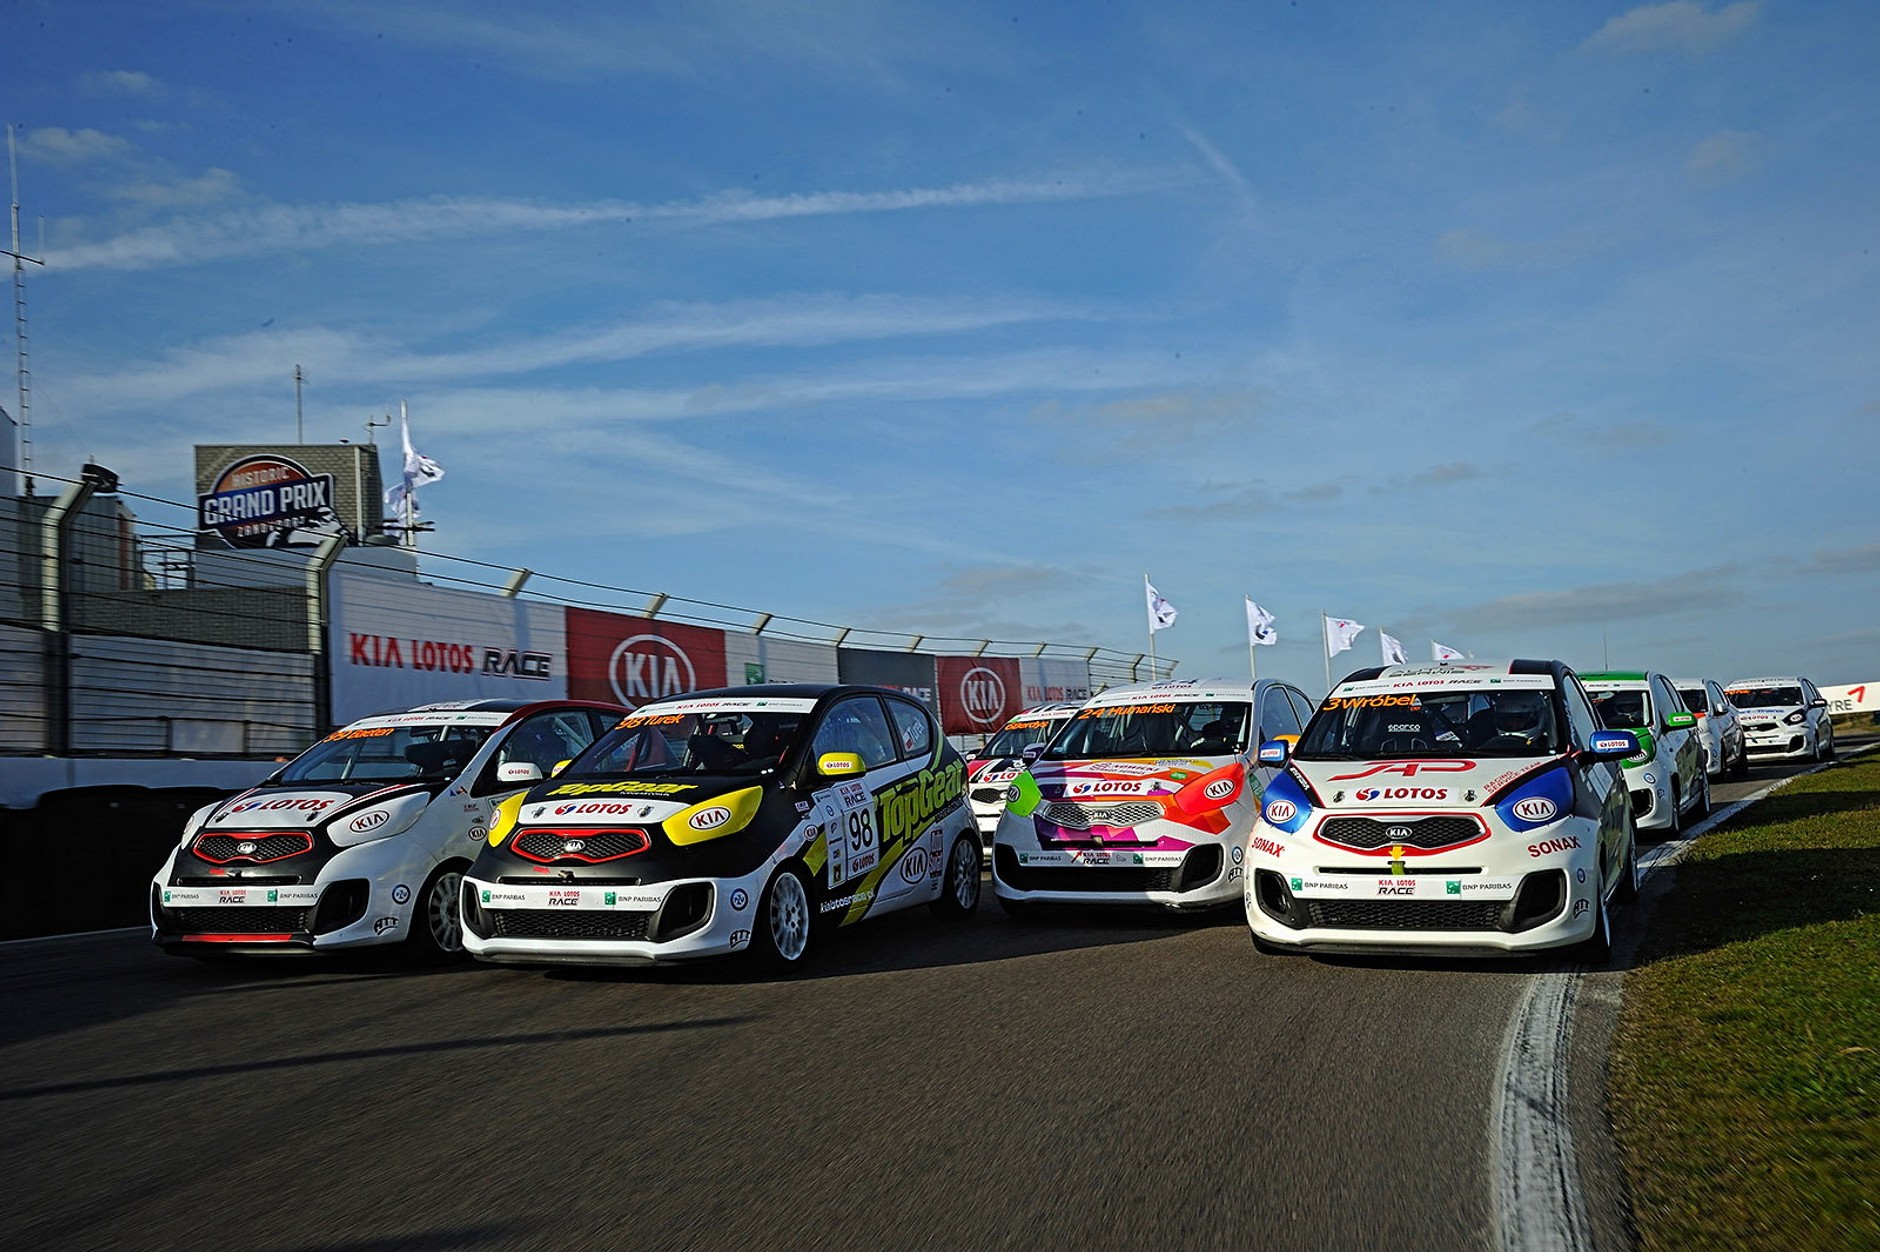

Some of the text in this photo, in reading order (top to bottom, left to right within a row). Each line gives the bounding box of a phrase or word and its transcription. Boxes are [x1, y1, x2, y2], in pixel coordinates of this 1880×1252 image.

[231, 466, 290, 487] HISTORIC
[204, 481, 326, 525] GRAND PRIX
[350, 632, 553, 681] KIA LOTOS RACE
[624, 652, 682, 699] KIA
[967, 680, 999, 710] KIA
[1066, 688, 1087, 701] RACE
[1322, 693, 1418, 711] 3 Wróbel
[1077, 704, 1176, 720] 24 Humański
[614, 713, 686, 731] 98 Turek
[1387, 724, 1421, 733] sparco
[840, 786, 850, 795] KIA
[1094, 782, 1142, 792] LOTOS
[1211, 782, 1232, 796] KIA
[1384, 788, 1448, 800] LOTOS
[258, 799, 335, 811] LOTOS
[844, 792, 867, 807] RACE
[879, 758, 964, 843] TopGear
[576, 804, 632, 814] LOTOS
[1271, 807, 1289, 817] KIA
[1522, 802, 1551, 816] KIA
[355, 816, 385, 830] KIA
[696, 810, 726, 827] KIA
[471, 828, 484, 839] KIA
[849, 808, 873, 851] 98
[1390, 828, 1411, 837] KIA
[567, 840, 583, 850] KIA
[1251, 837, 1282, 858] SONAX
[1527, 836, 1582, 858] SONAX
[859, 853, 875, 869] LOTOS
[905, 853, 924, 878] KIA
[1377, 887, 1415, 895] RACE
[1462, 883, 1478, 891] BNP
[548, 898, 579, 906] RACE
